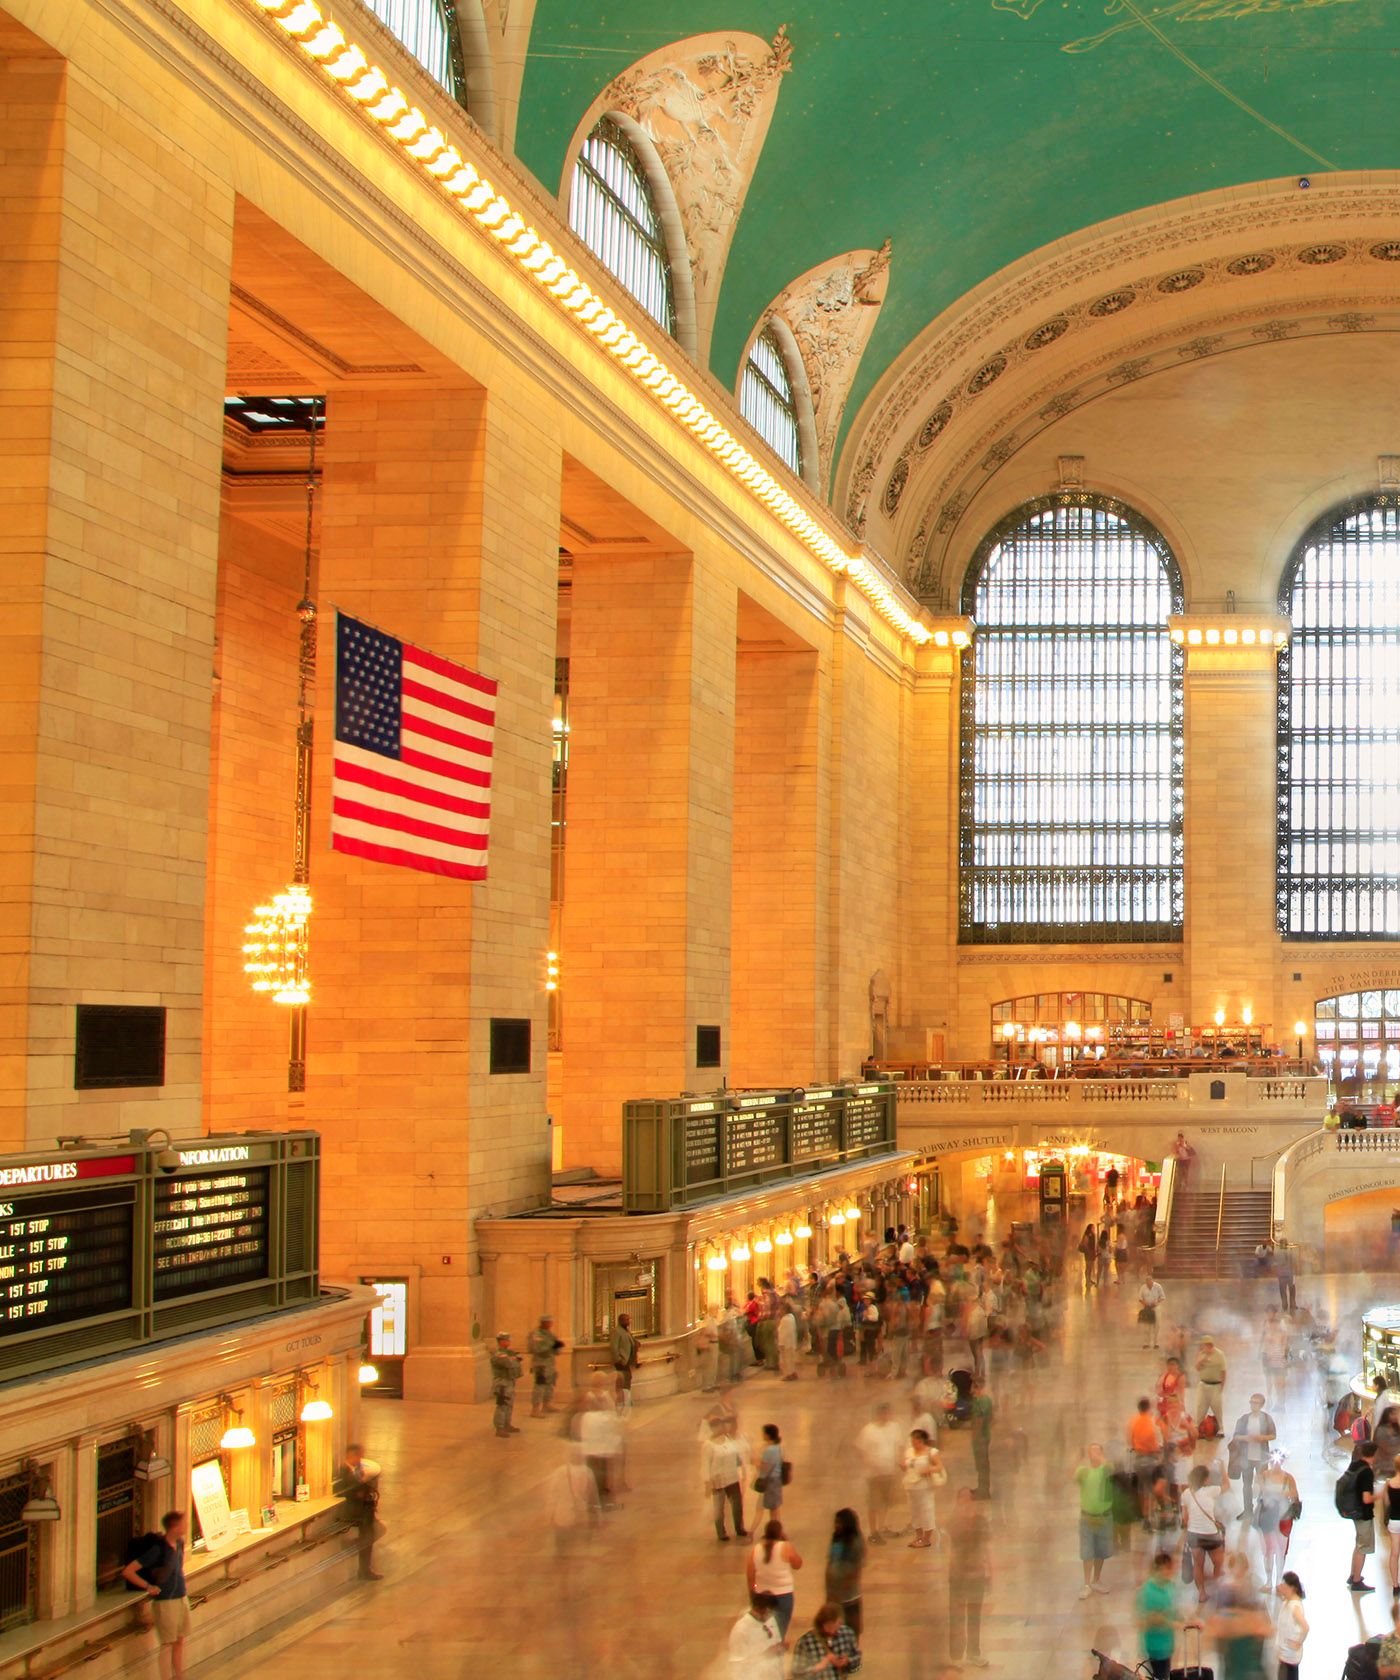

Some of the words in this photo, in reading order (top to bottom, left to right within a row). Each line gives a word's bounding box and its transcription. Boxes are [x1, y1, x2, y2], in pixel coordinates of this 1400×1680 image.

[918, 1140, 959, 1154] SUBWAY
[963, 1136, 1007, 1147] SHUTTLE
[179, 1146, 249, 1166] NFORMATION
[0, 1162, 78, 1185] EPARTURES
[1328, 1187, 1355, 1200] DINING
[10, 1223, 25, 1236] 1ST
[29, 1219, 49, 1234] STOP
[30, 1240, 44, 1254] 1ST
[48, 1237, 68, 1251] STOP
[29, 1260, 44, 1274] 1ST
[48, 1256, 67, 1271] STOP
[9, 1284, 24, 1298] 1ST
[28, 1280, 48, 1295] STOP
[9, 1304, 24, 1319] 1ST
[28, 1300, 48, 1315] STOP
